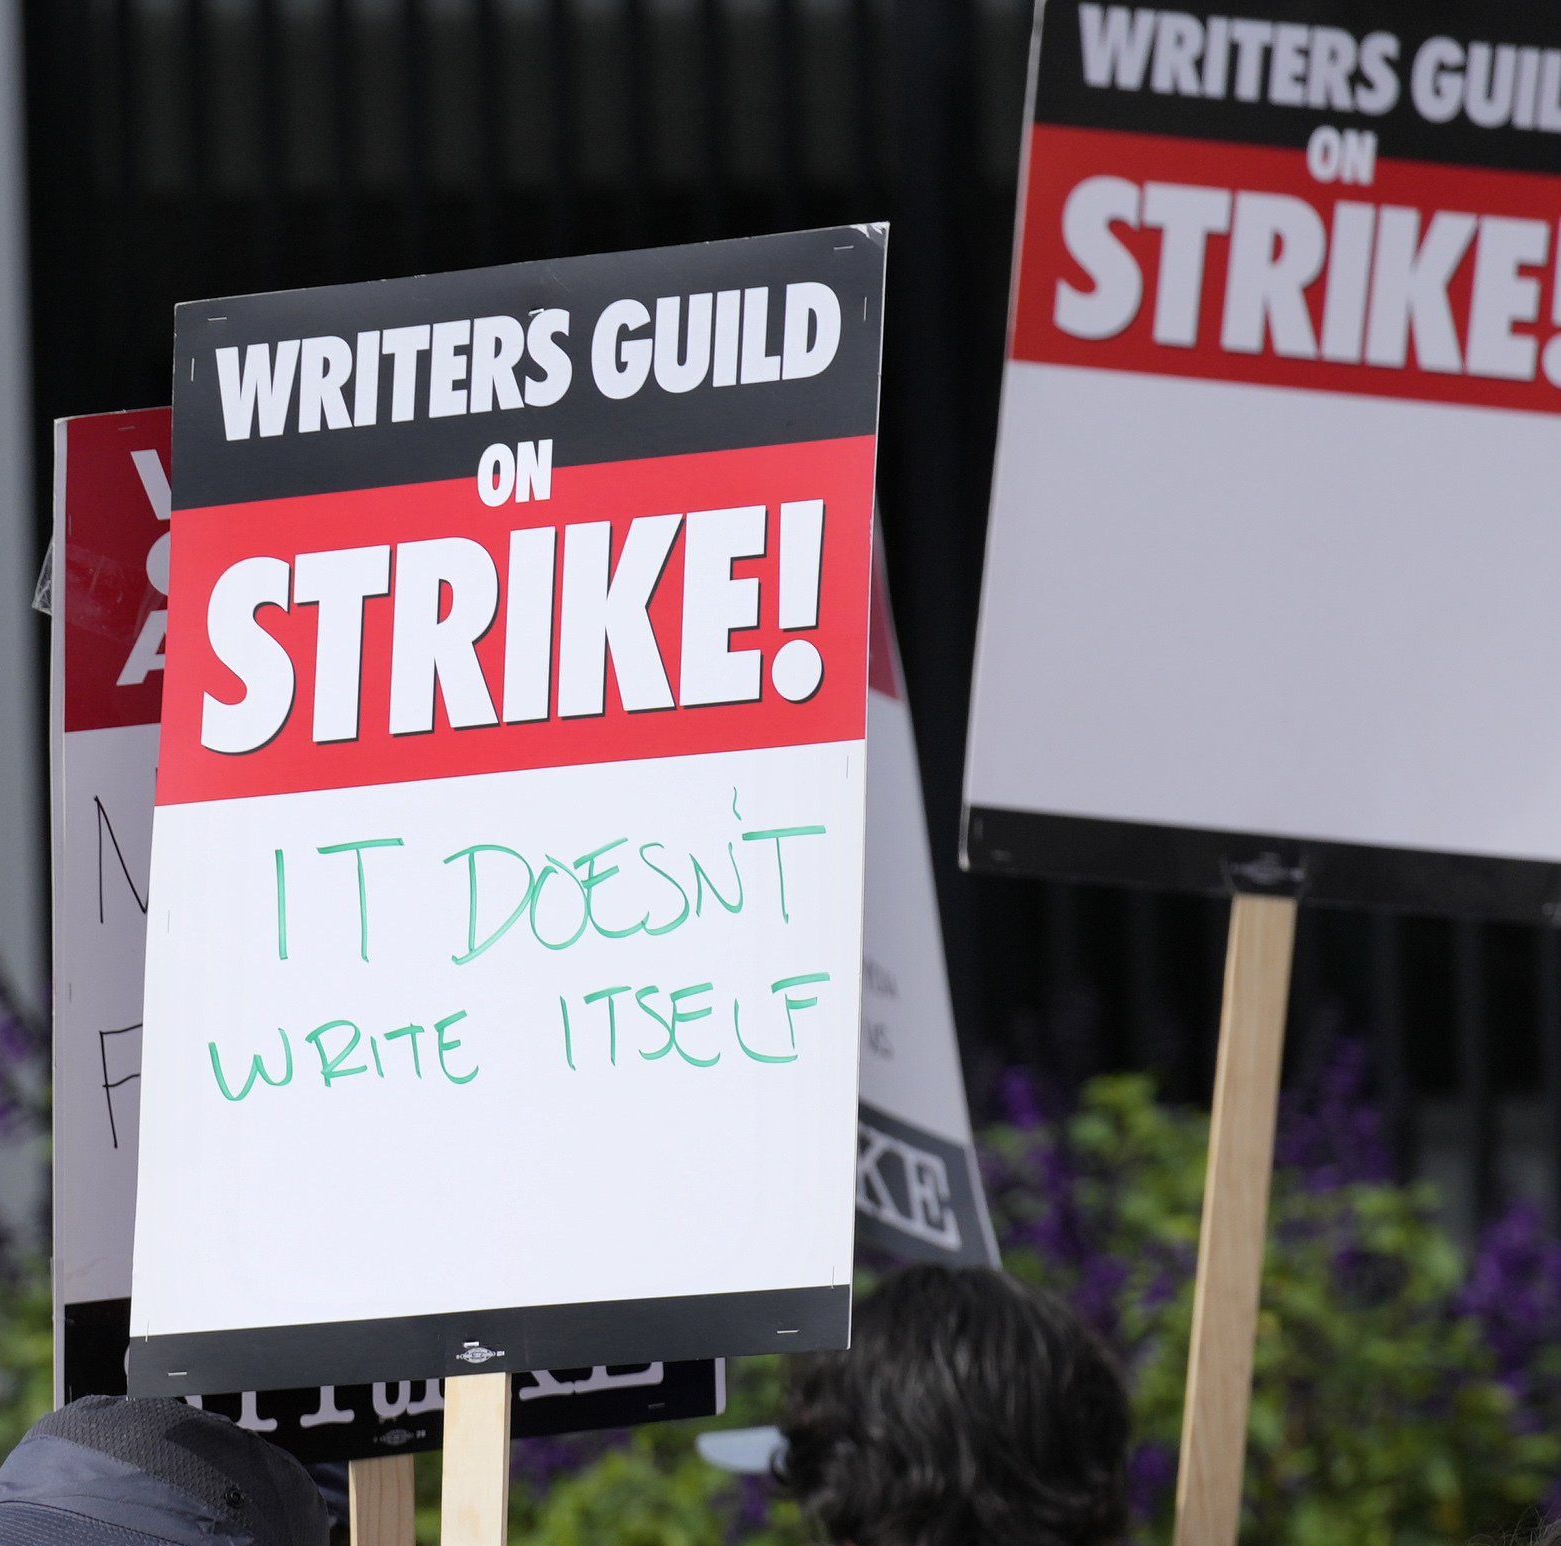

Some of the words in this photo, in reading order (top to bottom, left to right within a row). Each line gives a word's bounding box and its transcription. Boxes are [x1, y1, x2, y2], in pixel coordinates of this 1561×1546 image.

[1078, 3, 1400, 117] WRITERS
[1411, 35, 1561, 134] GUIL
[1306, 124, 1378, 187] ON
[215, 307, 573, 442] WRITERS
[590, 281, 842, 400] GUILD
[476, 438, 553, 508] ON
[201, 499, 826, 756] STRIKE!
[273, 836, 405, 965] IT
[443, 785, 828, 966] DOESN'T
[207, 1009, 480, 1103] WRITE
[558, 971, 831, 1072] ITSELF
